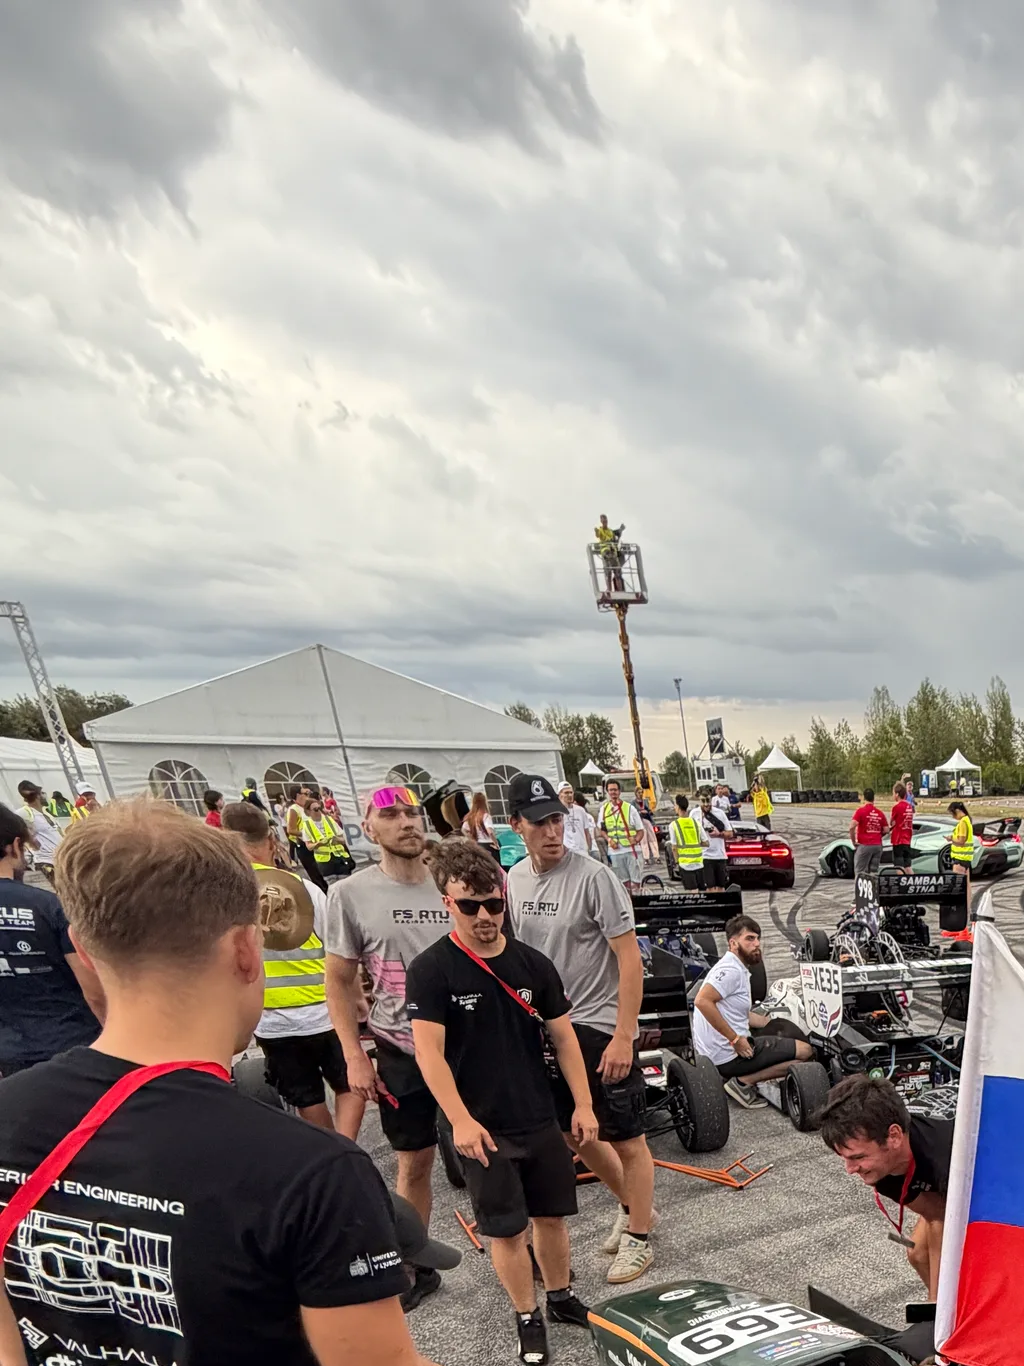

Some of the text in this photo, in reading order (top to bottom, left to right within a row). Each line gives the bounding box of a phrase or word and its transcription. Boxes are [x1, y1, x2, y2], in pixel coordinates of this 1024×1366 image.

[900, 876, 944, 886] SAMBAA
[858, 878, 873, 900] 998
[908, 885, 935, 894] STNA
[538, 902, 559, 912] RTU
[393, 909, 449, 920] FS RTU
[811, 966, 840, 995] XE35
[64, 1180, 185, 1216] ENGINEERING
